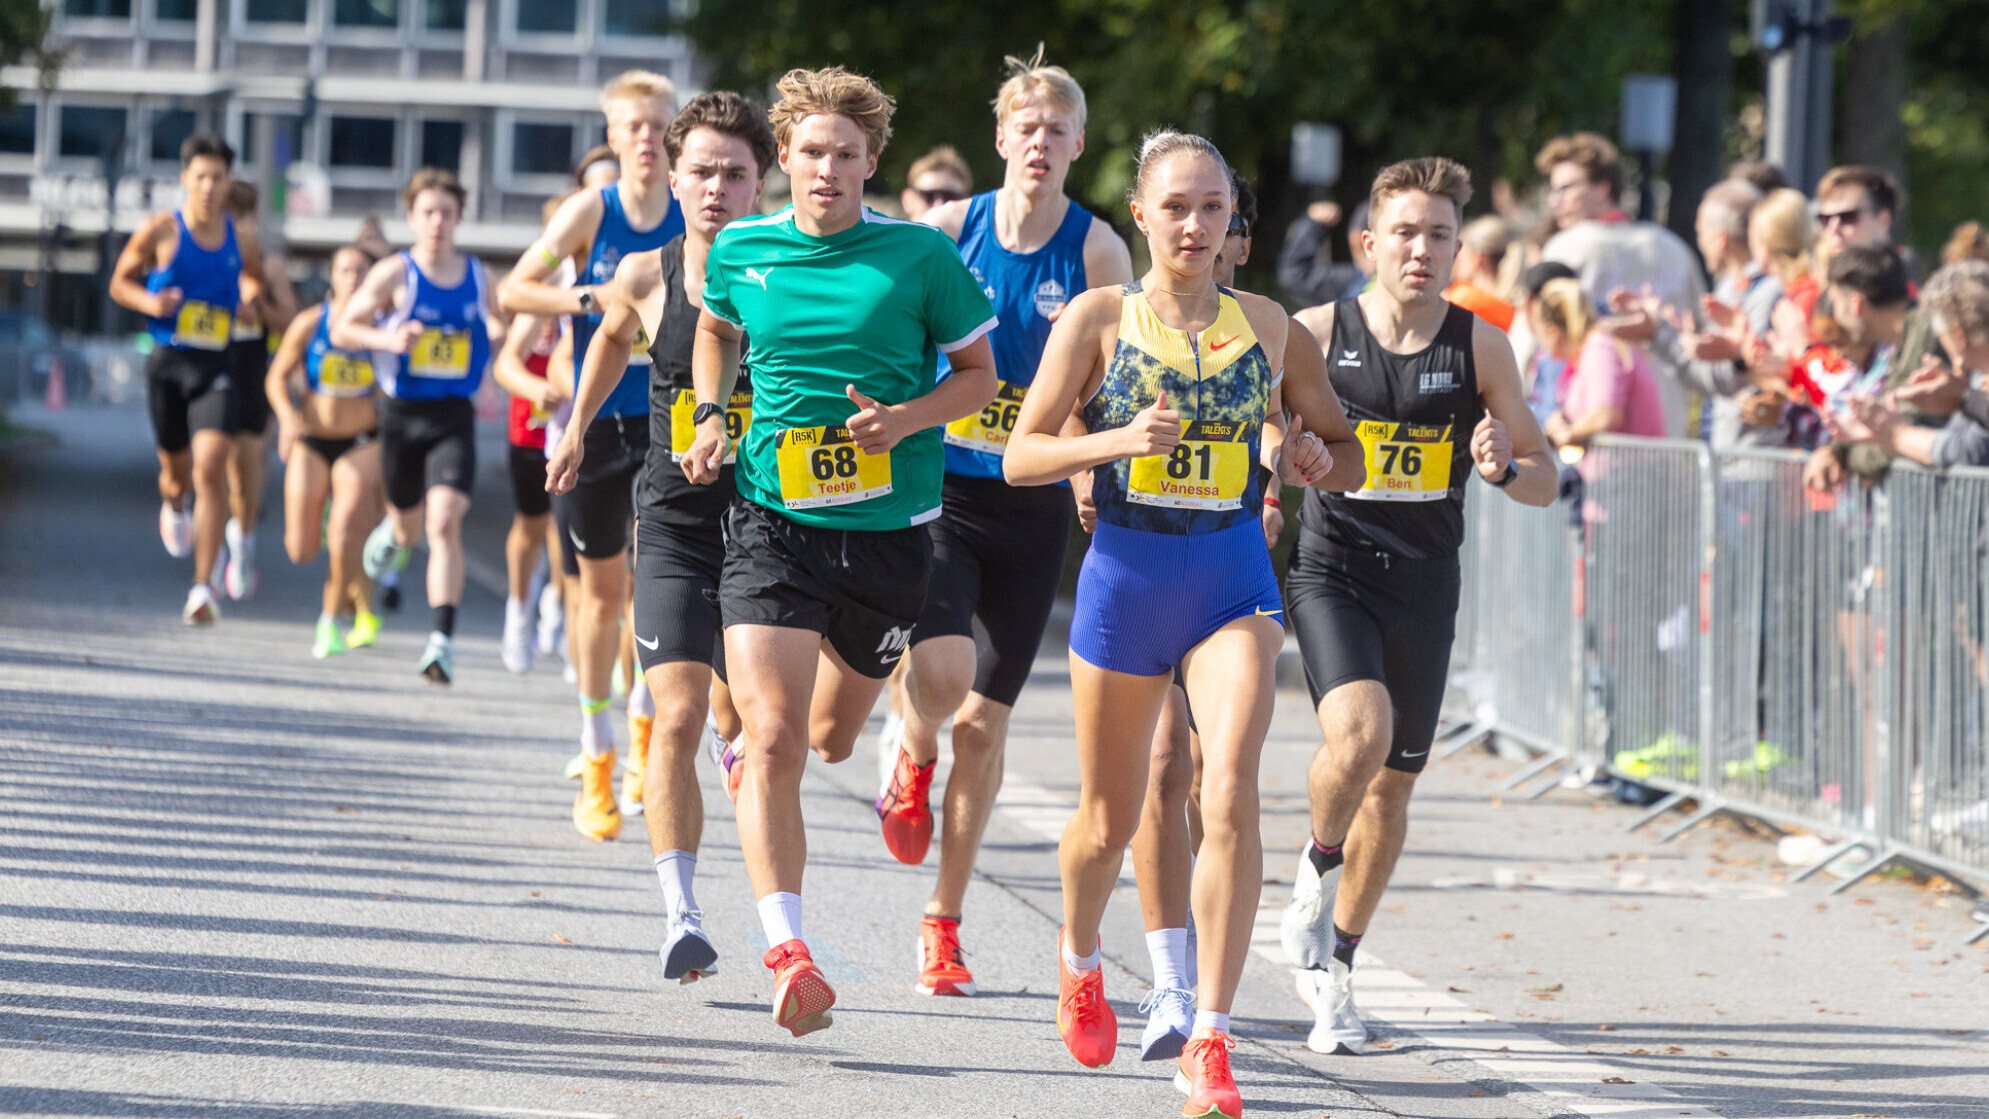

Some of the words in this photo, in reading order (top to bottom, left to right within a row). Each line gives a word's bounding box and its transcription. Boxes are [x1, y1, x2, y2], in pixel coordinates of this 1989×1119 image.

[725, 411, 743, 440] 9
[980, 401, 1021, 433] 56
[1200, 424, 1231, 436] TALENTS
[811, 446, 858, 481] 68
[1166, 443, 1211, 480] 81
[1379, 444, 1422, 477] 76
[818, 480, 857, 495] Teetje
[1160, 481, 1220, 497] Vanessa
[1387, 477, 1412, 489] Ben
